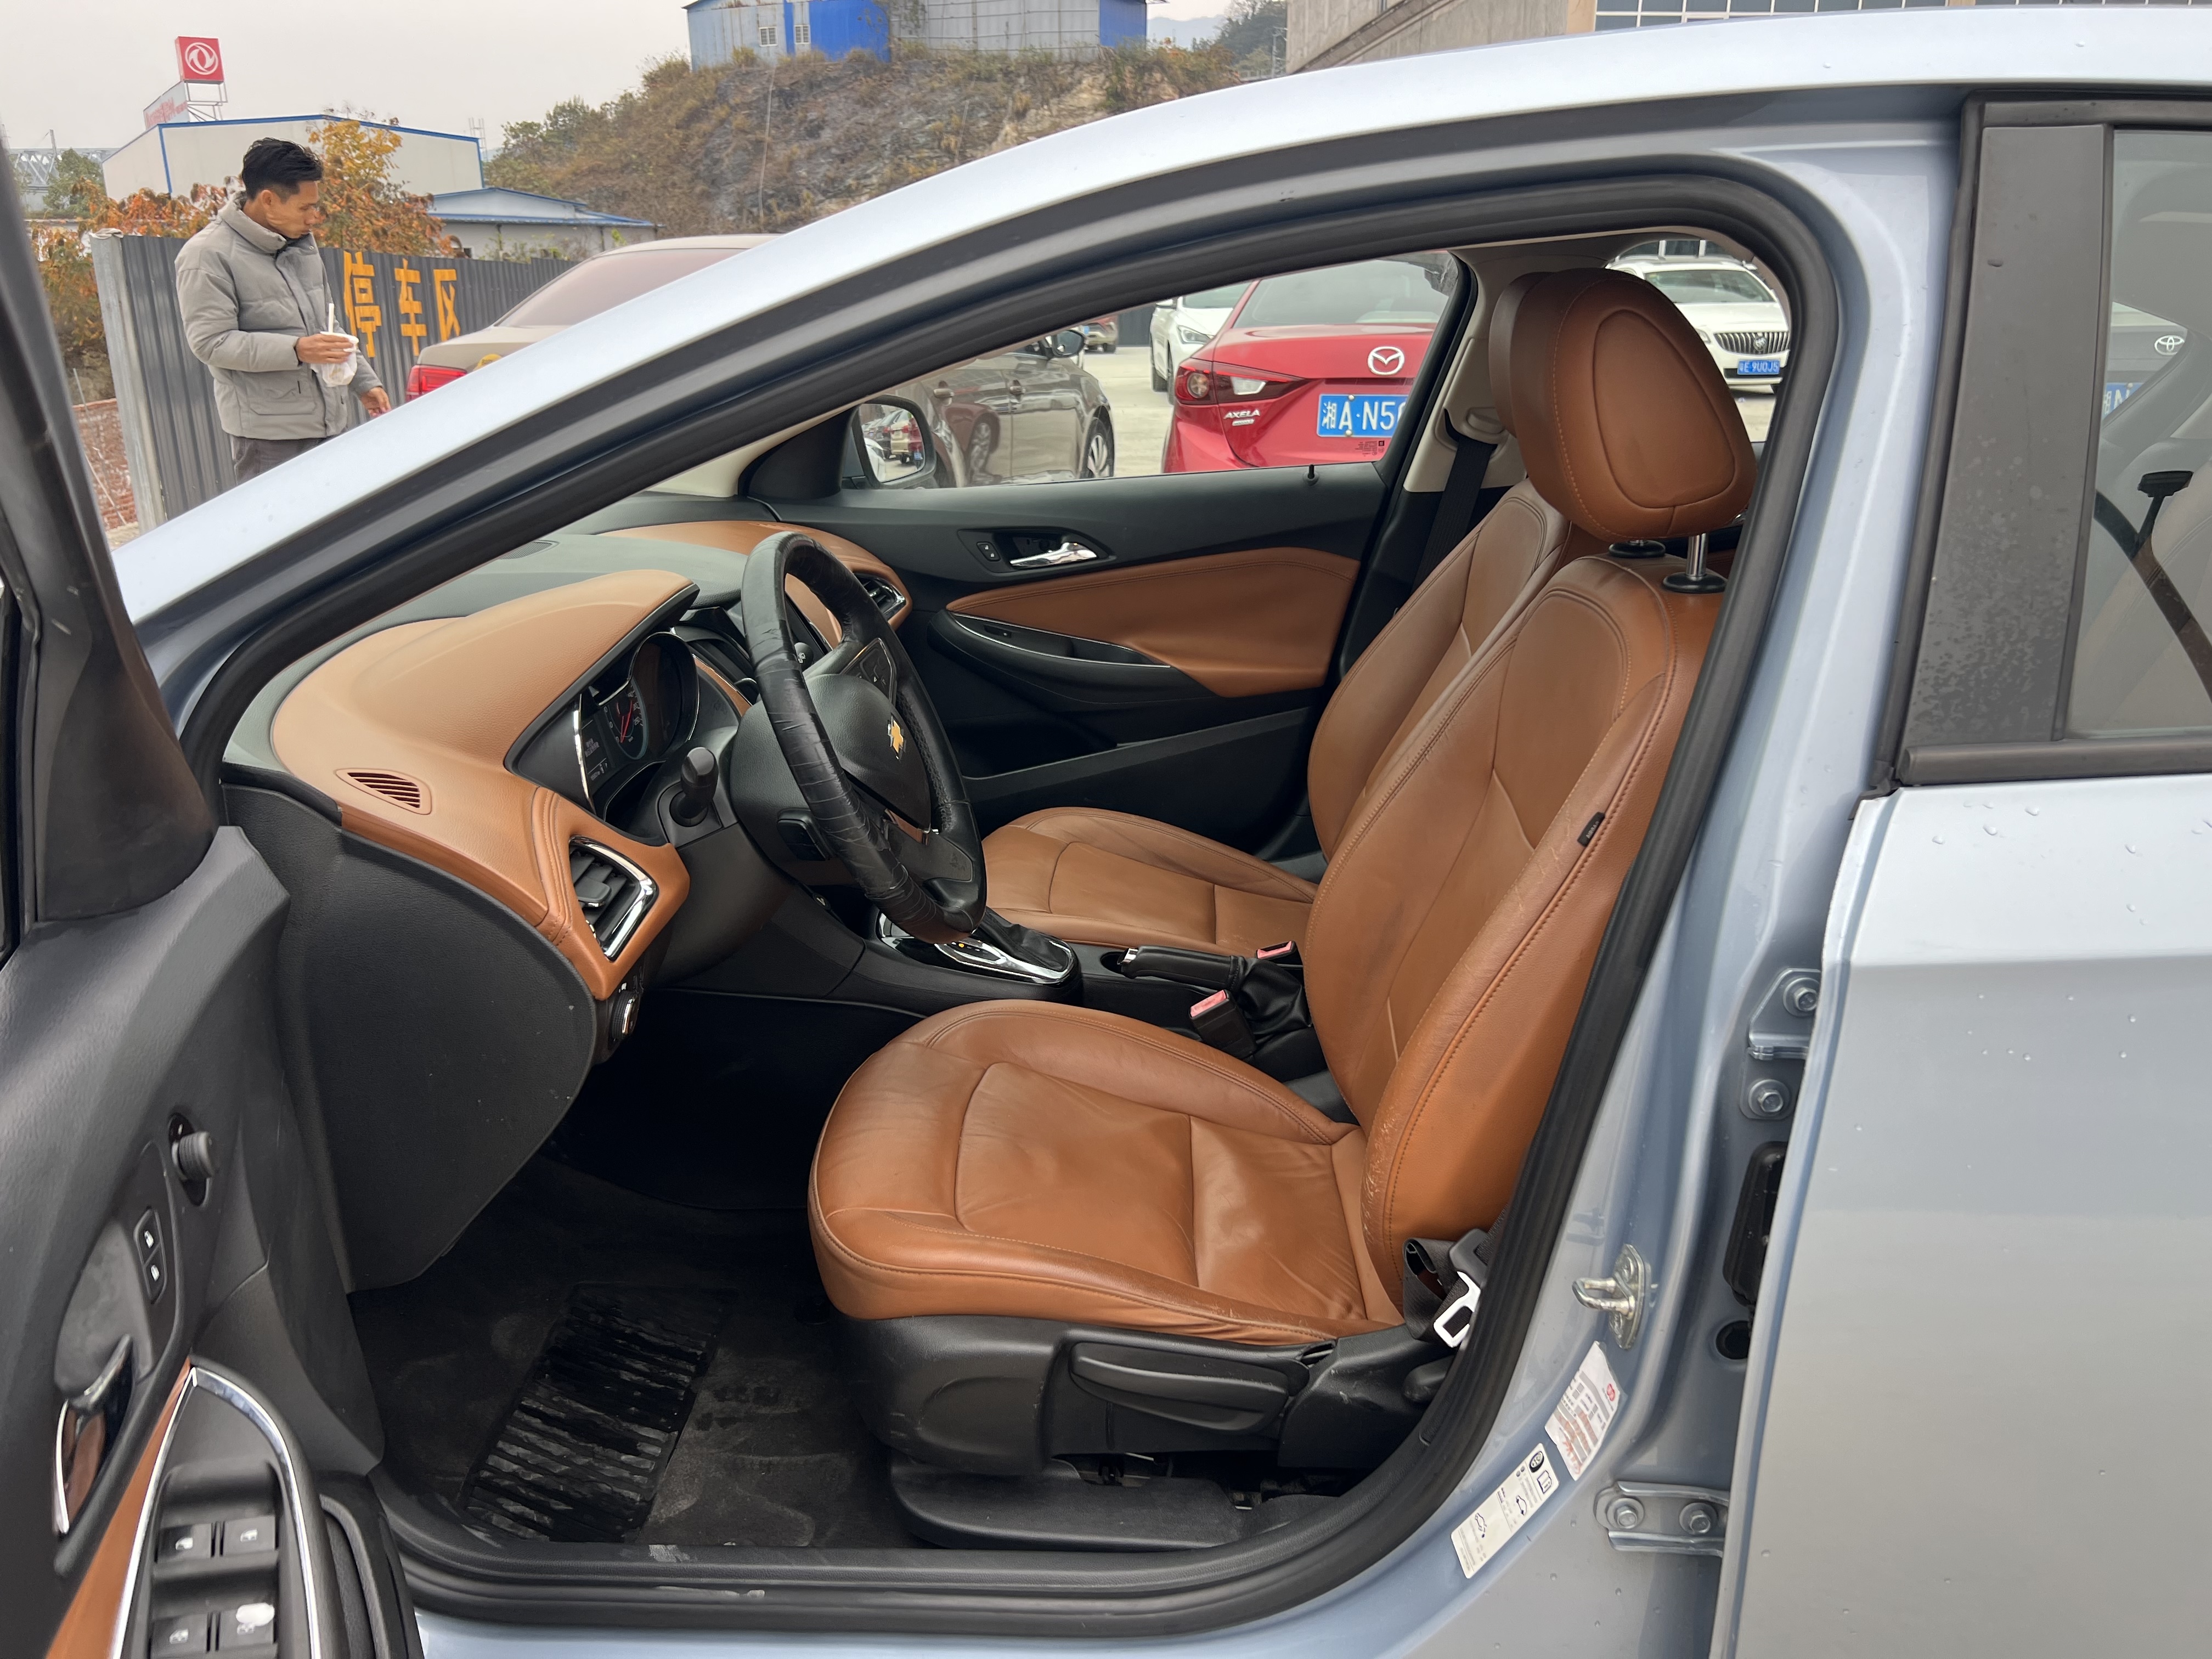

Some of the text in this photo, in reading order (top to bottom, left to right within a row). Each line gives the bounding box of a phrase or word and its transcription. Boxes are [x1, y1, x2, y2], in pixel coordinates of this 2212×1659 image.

[343, 251, 461, 358] 停车区
[1223, 409, 1260, 420] AXELA
